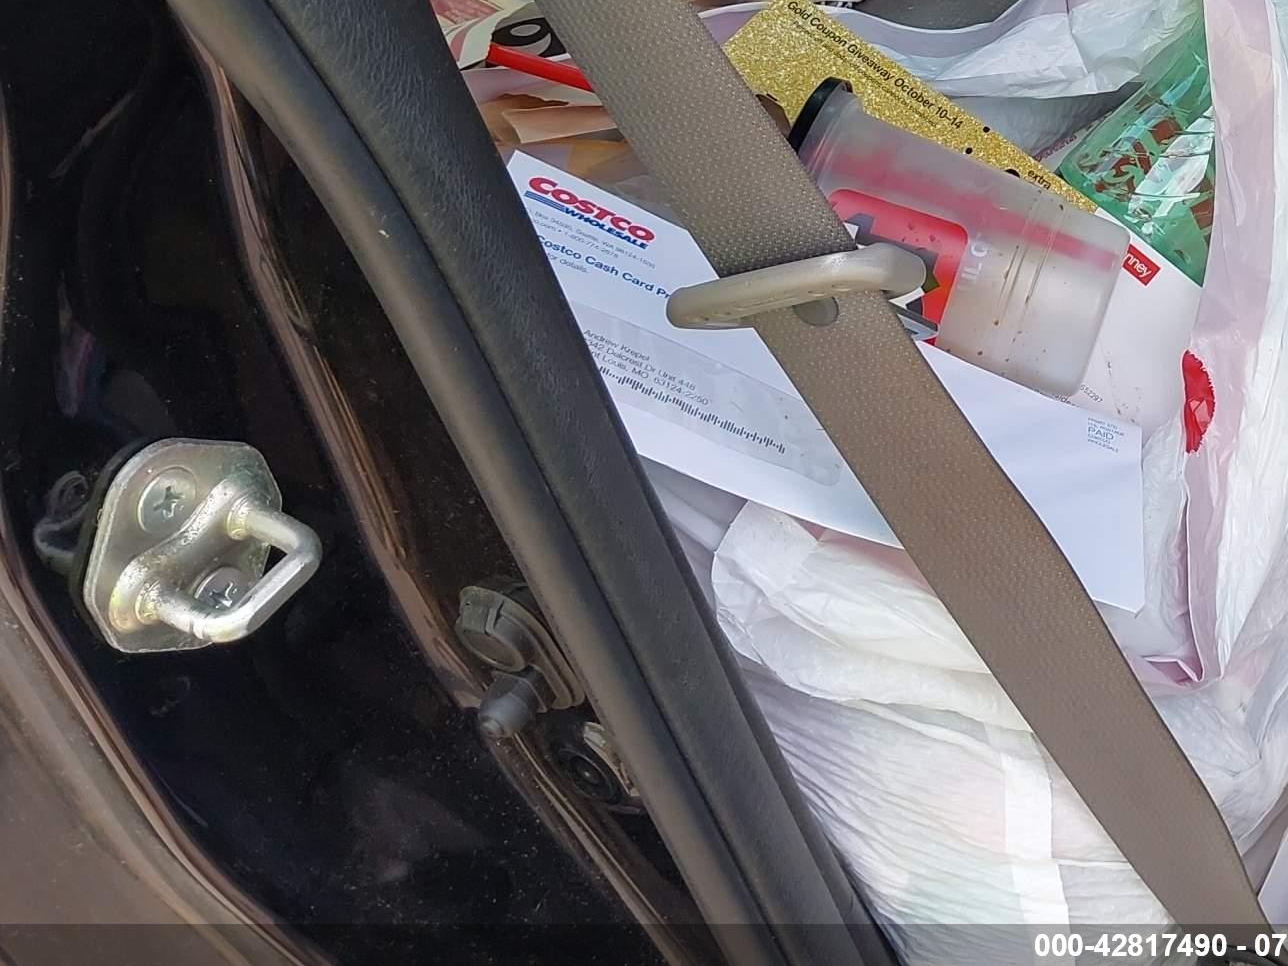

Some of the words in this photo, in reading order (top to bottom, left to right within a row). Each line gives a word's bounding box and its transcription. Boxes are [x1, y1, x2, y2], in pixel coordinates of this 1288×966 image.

[786, 0, 812, 22] Gold
[808, 15, 848, 49] Coupon
[846, 42, 895, 83] Giveaway
[893, 76, 936, 112] October
[1024, 169, 1054, 191] extra
[529, 177, 655, 243] COSTCO
[564, 207, 649, 249] WHOLESALE
[536, 235, 582, 260] Costco
[584, 254, 619, 277] Cash
[621, 271, 655, 292] Card
[584, 328, 618, 348] Andrew
[631, 368, 649, 380] MO
[644, 364, 656, 373] Dr
[1087, 426, 1115, 441] PAID
